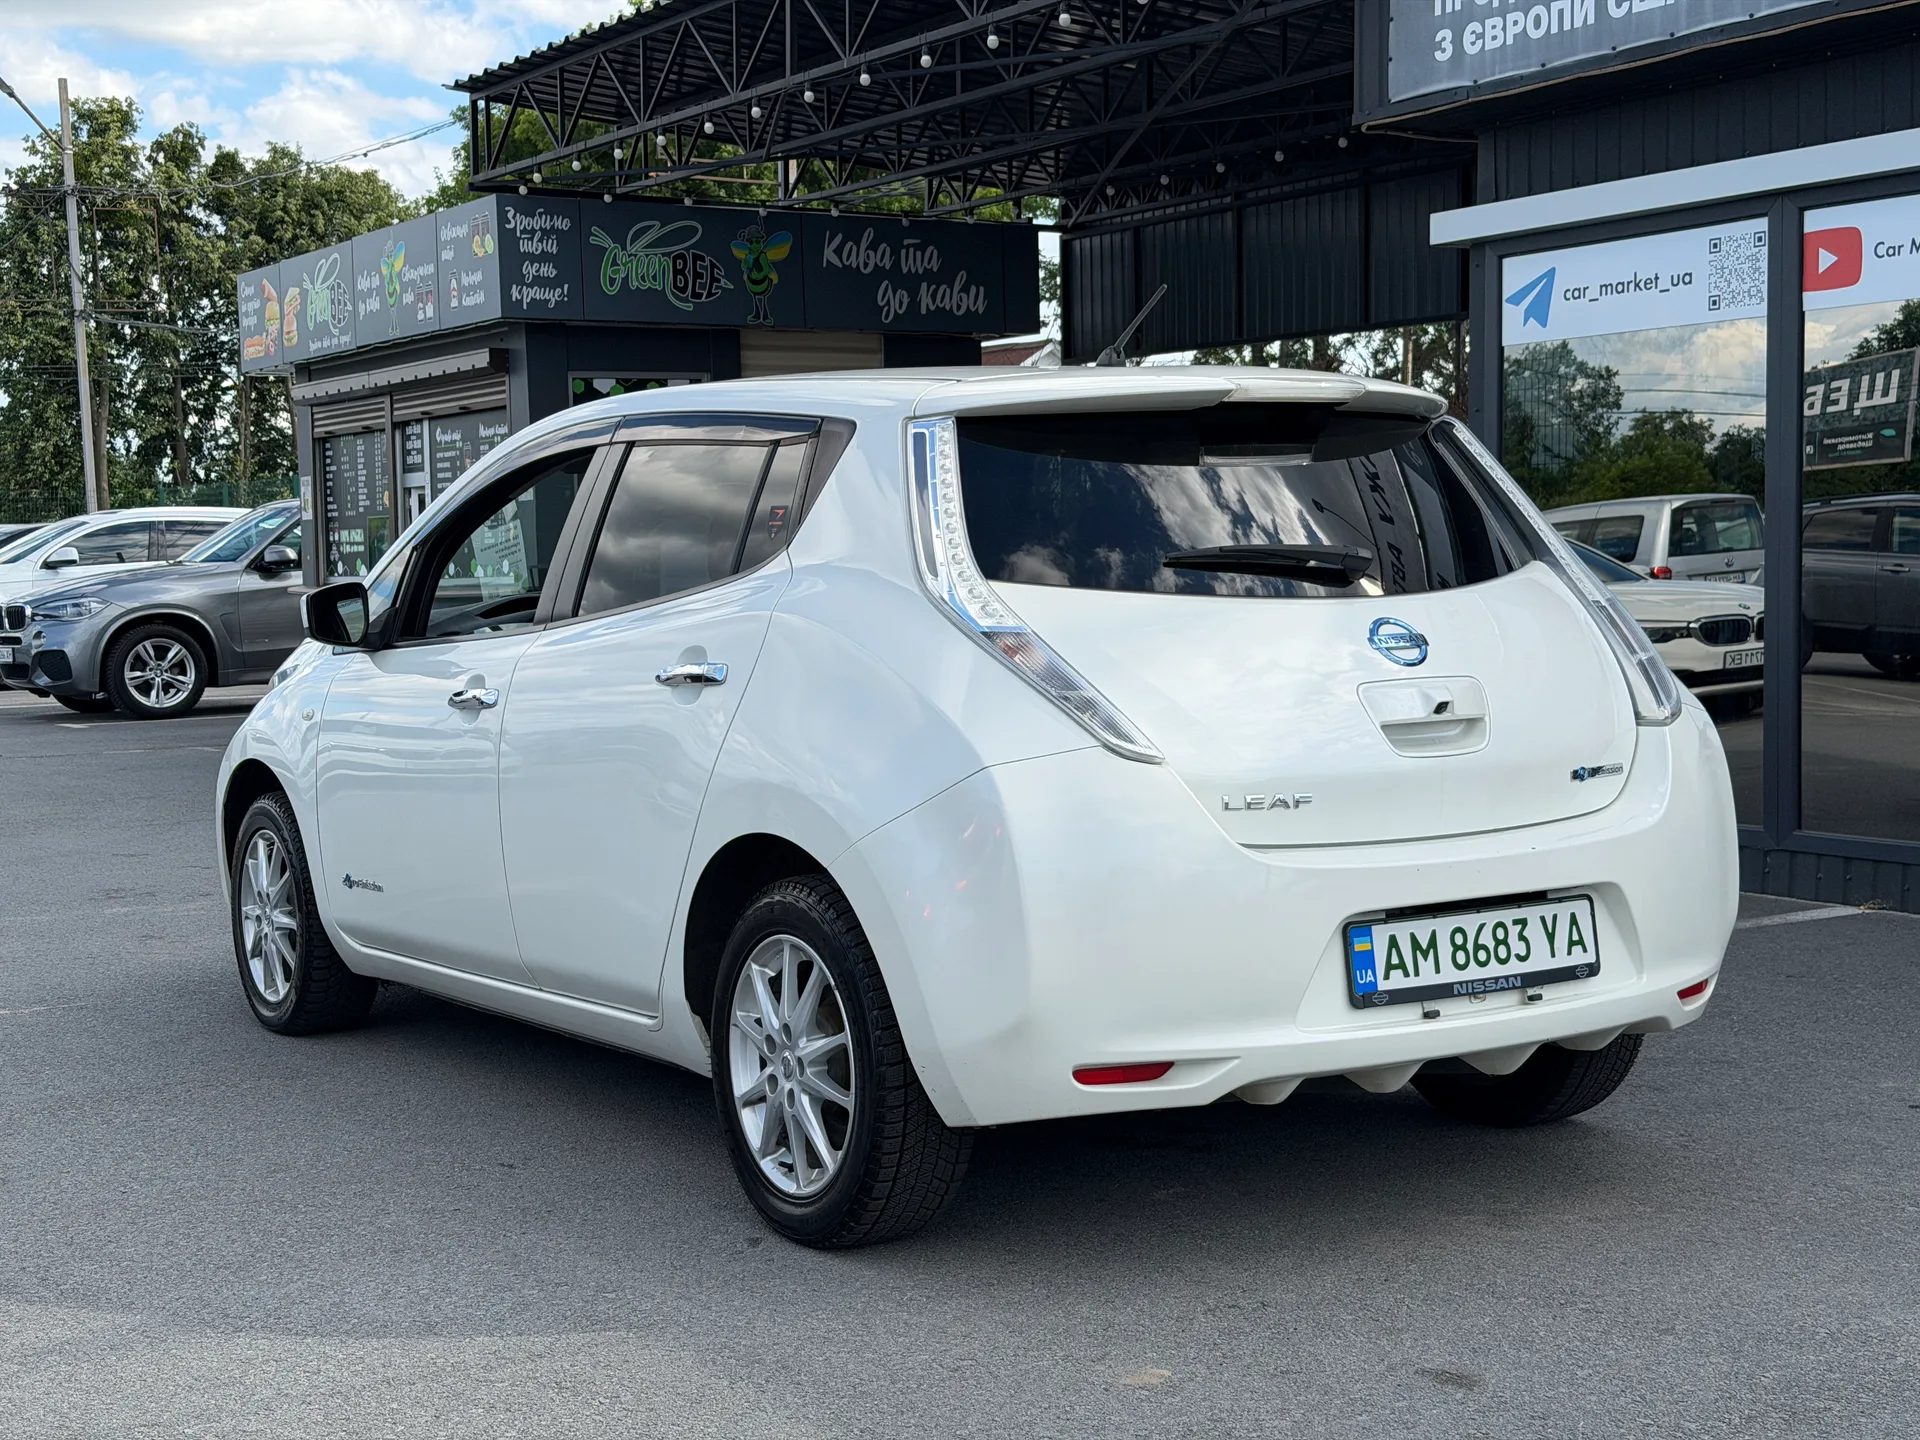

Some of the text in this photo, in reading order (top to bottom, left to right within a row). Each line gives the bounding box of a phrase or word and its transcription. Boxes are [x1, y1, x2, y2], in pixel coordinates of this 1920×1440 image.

[1434, 29, 1454, 62] З
[1462, 0, 1596, 55] ЄВРОПИ
[504, 207, 572, 237] Зробимо
[519, 234, 559, 255] твій
[823, 228, 942, 275] Кава та
[1873, 240, 1905, 260] Car
[522, 260, 558, 284] день
[510, 283, 569, 310] краще!
[877, 270, 988, 324] до кави
[1563, 269, 1693, 302] car_market_ua
[1377, 634, 1425, 646] NISSAN
[1221, 793, 1313, 811] LEAF
[1382, 911, 1588, 981] AM 8683 YA
[1356, 968, 1375, 984] UA
[1453, 975, 1522, 996] NISSAN
